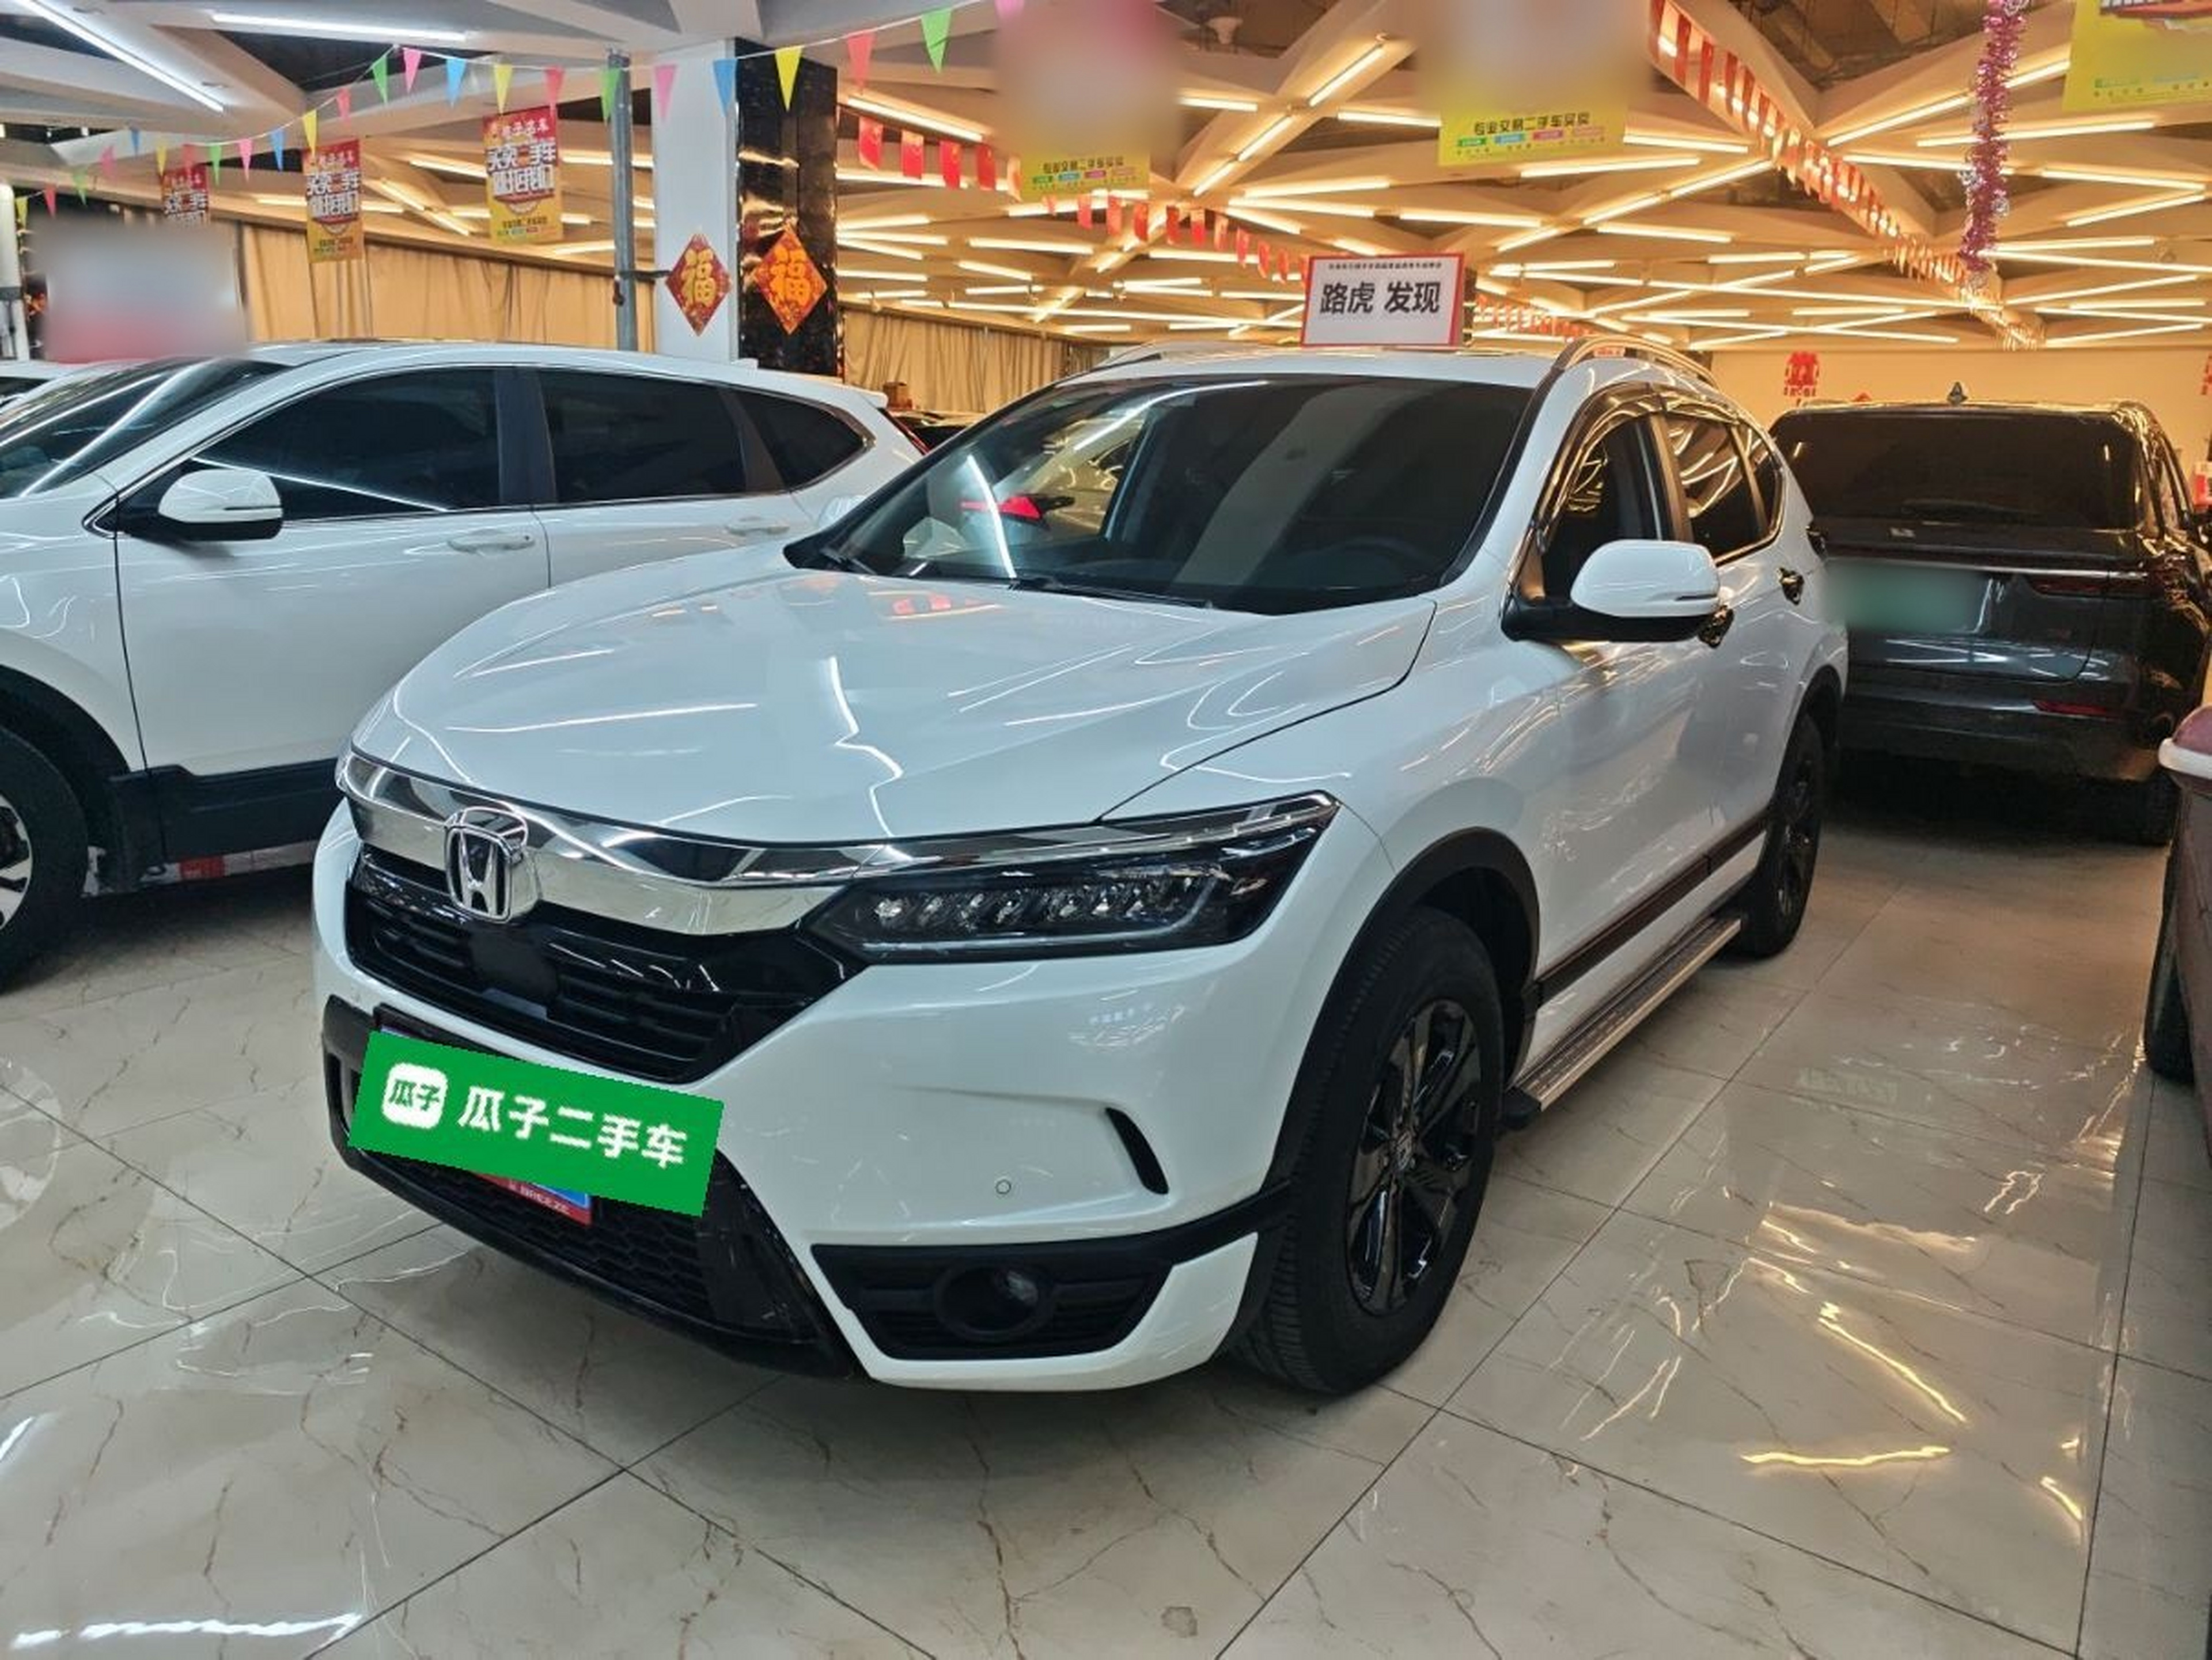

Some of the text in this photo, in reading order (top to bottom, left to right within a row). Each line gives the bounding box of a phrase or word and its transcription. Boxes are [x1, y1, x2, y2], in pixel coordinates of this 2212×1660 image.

[680, 248, 716, 309] 福
[769, 247, 811, 306] 福
[1319, 281, 1441, 314] 路虎 发现
